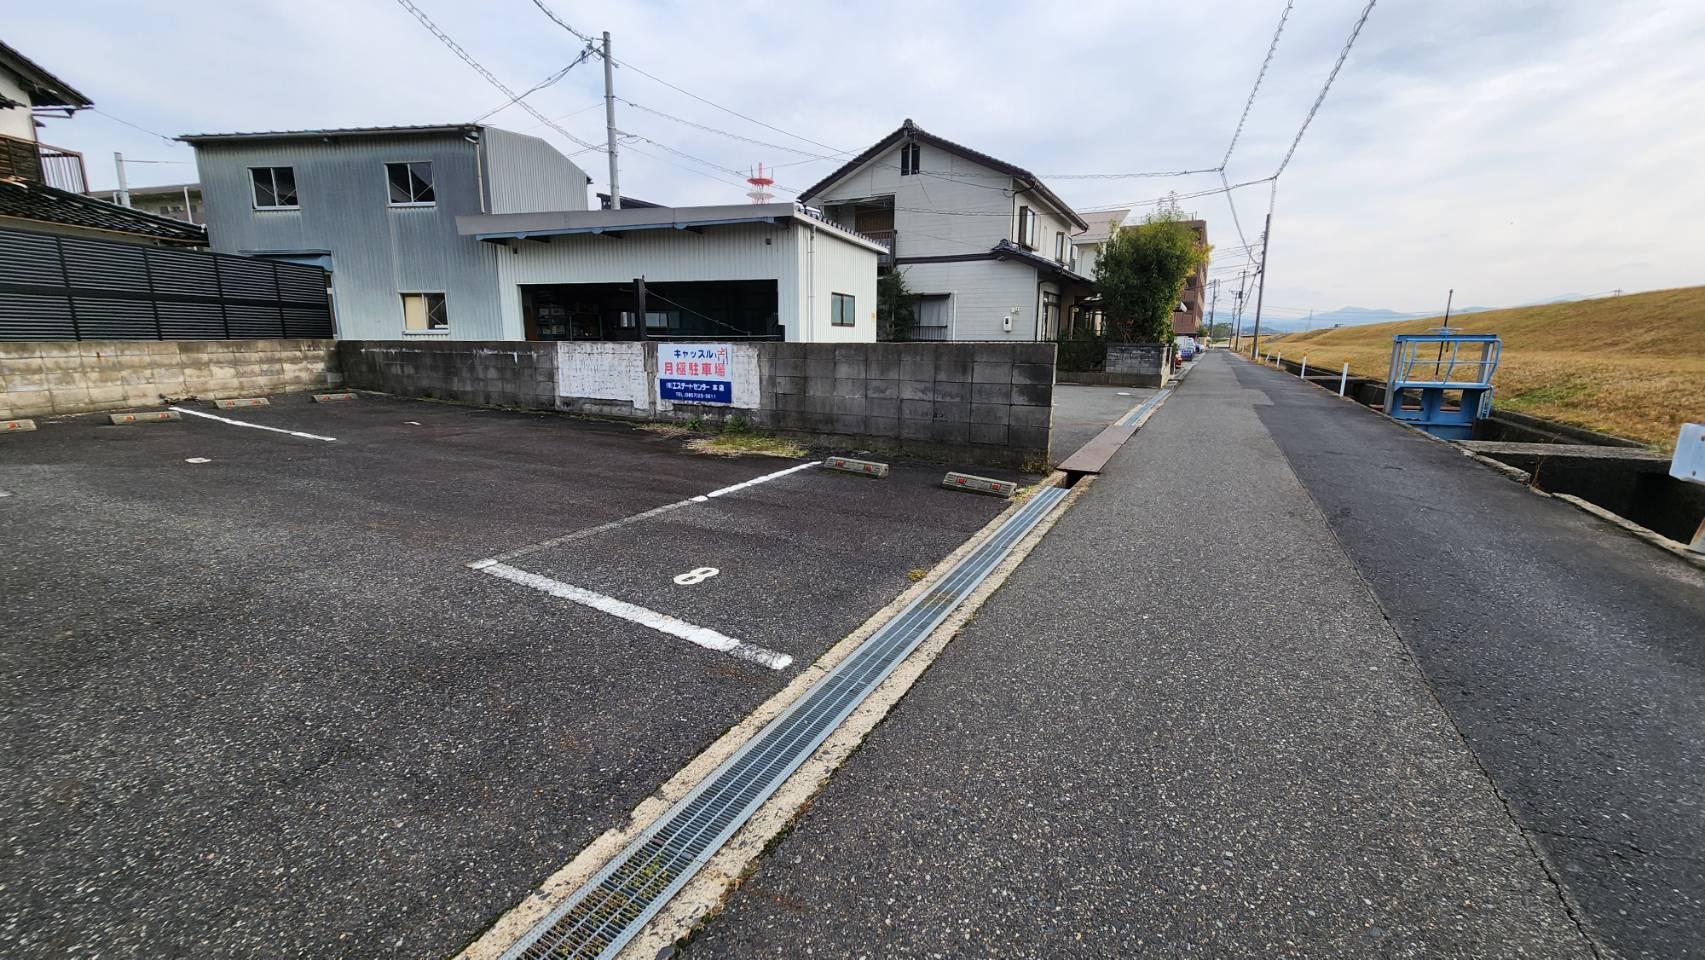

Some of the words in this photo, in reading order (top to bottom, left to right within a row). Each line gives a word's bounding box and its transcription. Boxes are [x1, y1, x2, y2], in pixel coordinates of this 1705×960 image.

[664, 361, 726, 377] 月極駐車場
[673, 567, 720, 585] 8
